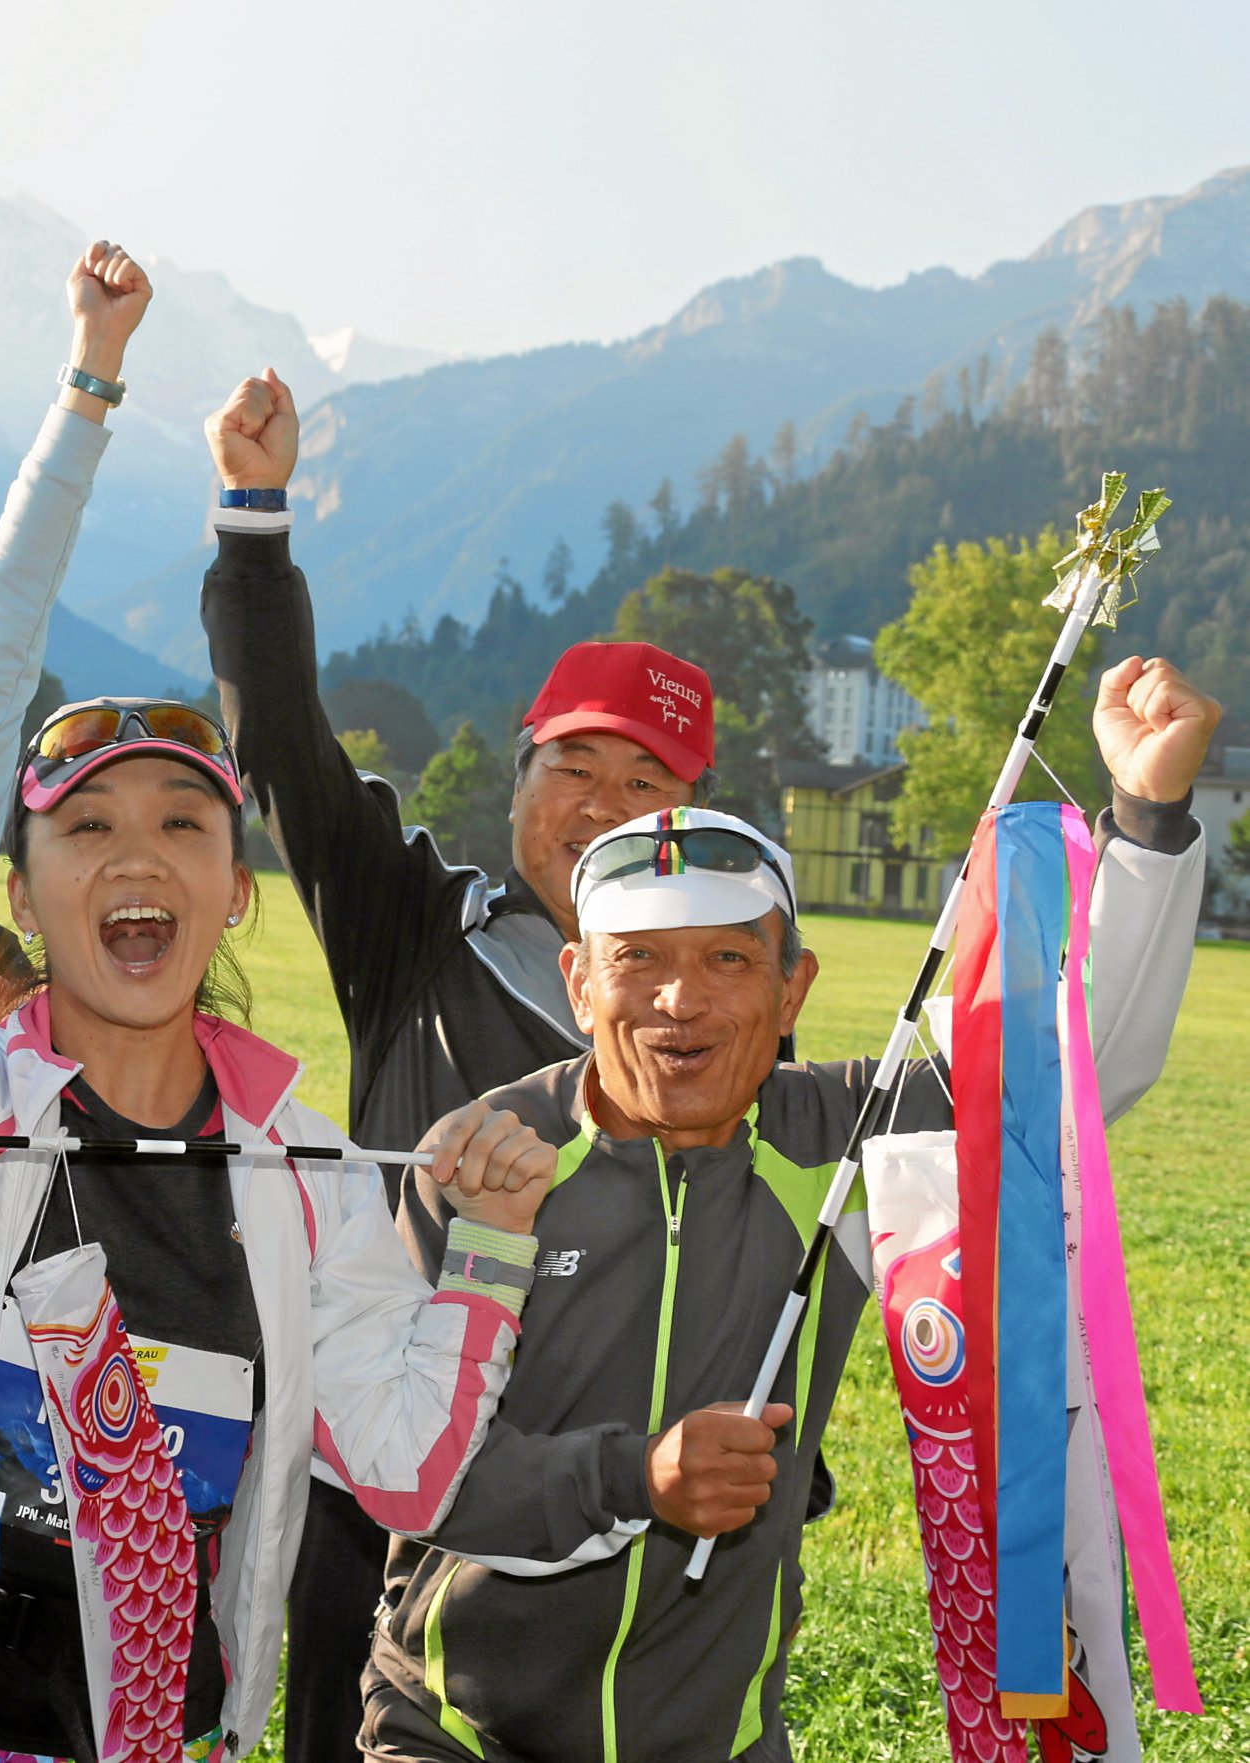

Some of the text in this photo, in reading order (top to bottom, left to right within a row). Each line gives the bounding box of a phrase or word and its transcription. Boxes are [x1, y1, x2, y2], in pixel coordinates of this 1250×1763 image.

[646, 667, 702, 709] Vienna
[134, 1350, 159, 1359] RAU
[16, 1505, 39, 1522] JPN
[45, 1512, 70, 1531] Mat
